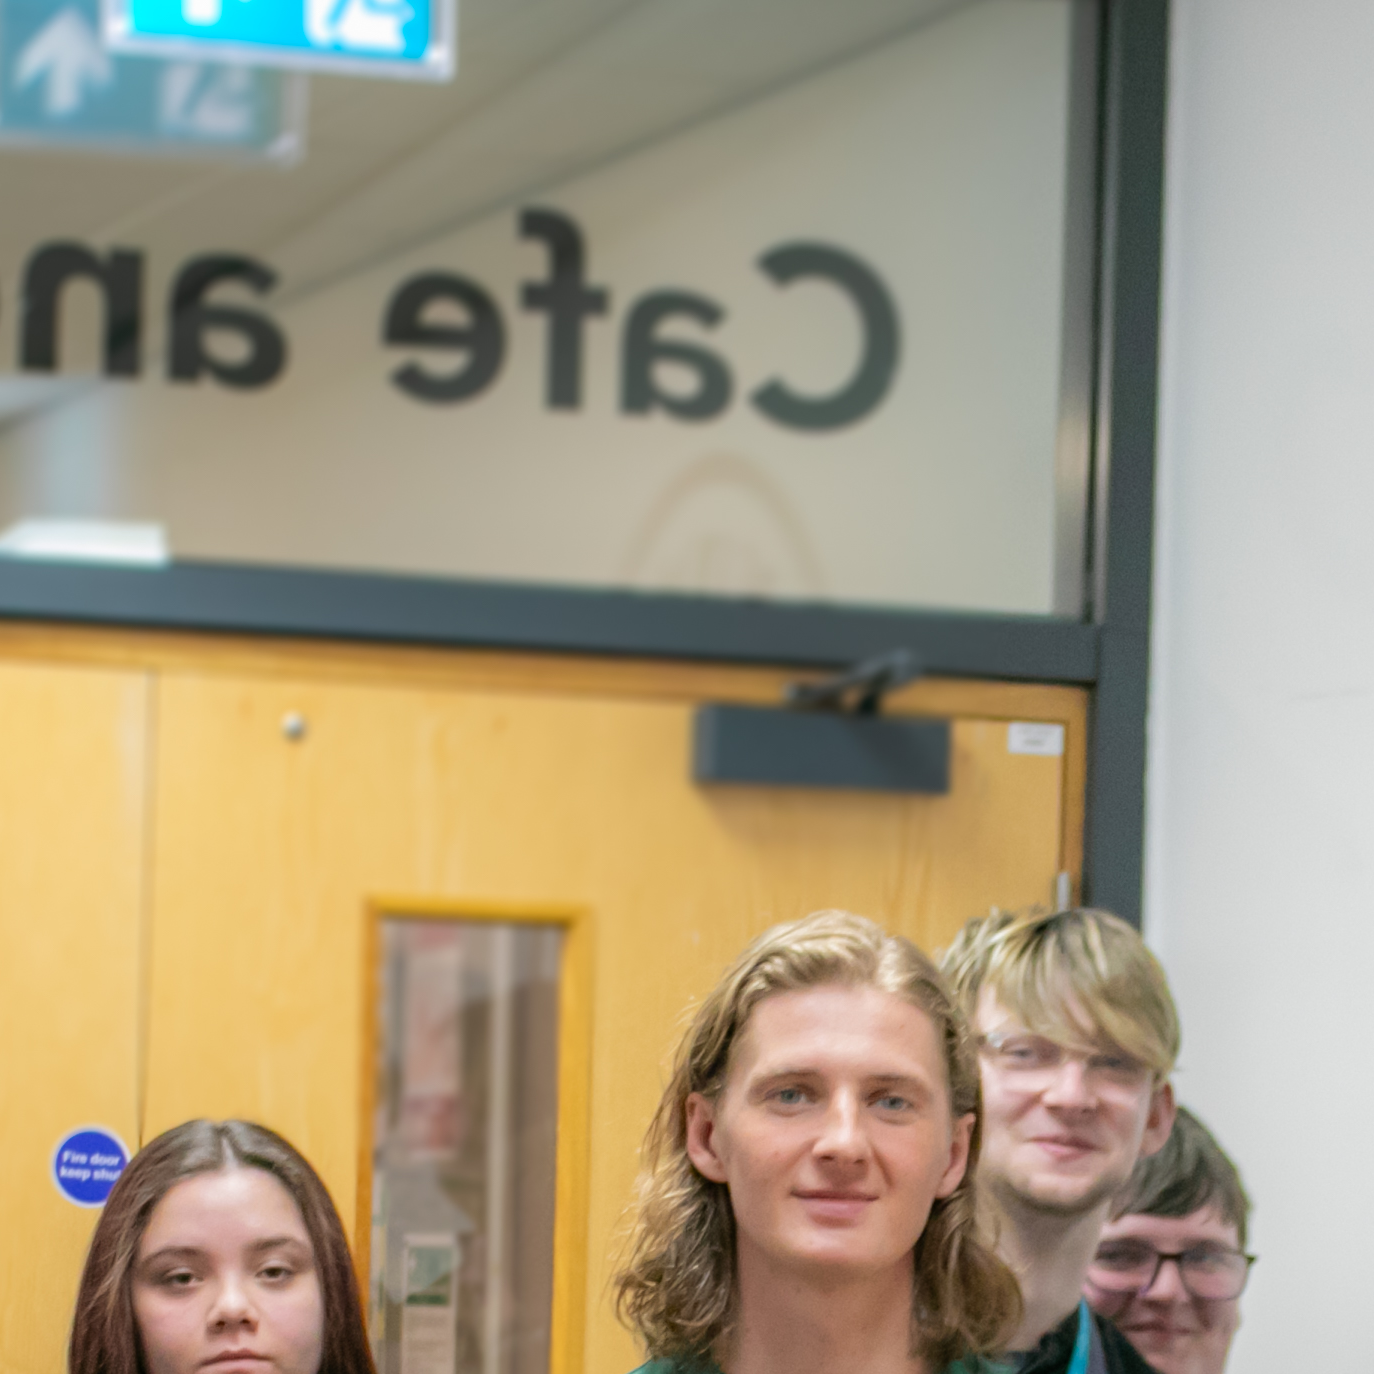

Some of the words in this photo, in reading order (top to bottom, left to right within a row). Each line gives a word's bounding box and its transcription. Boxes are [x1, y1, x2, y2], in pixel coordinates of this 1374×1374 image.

[62, 1150, 88, 1164] Fire
[90, 1152, 122, 1166] door
[59, 1165, 91, 1182] keep
